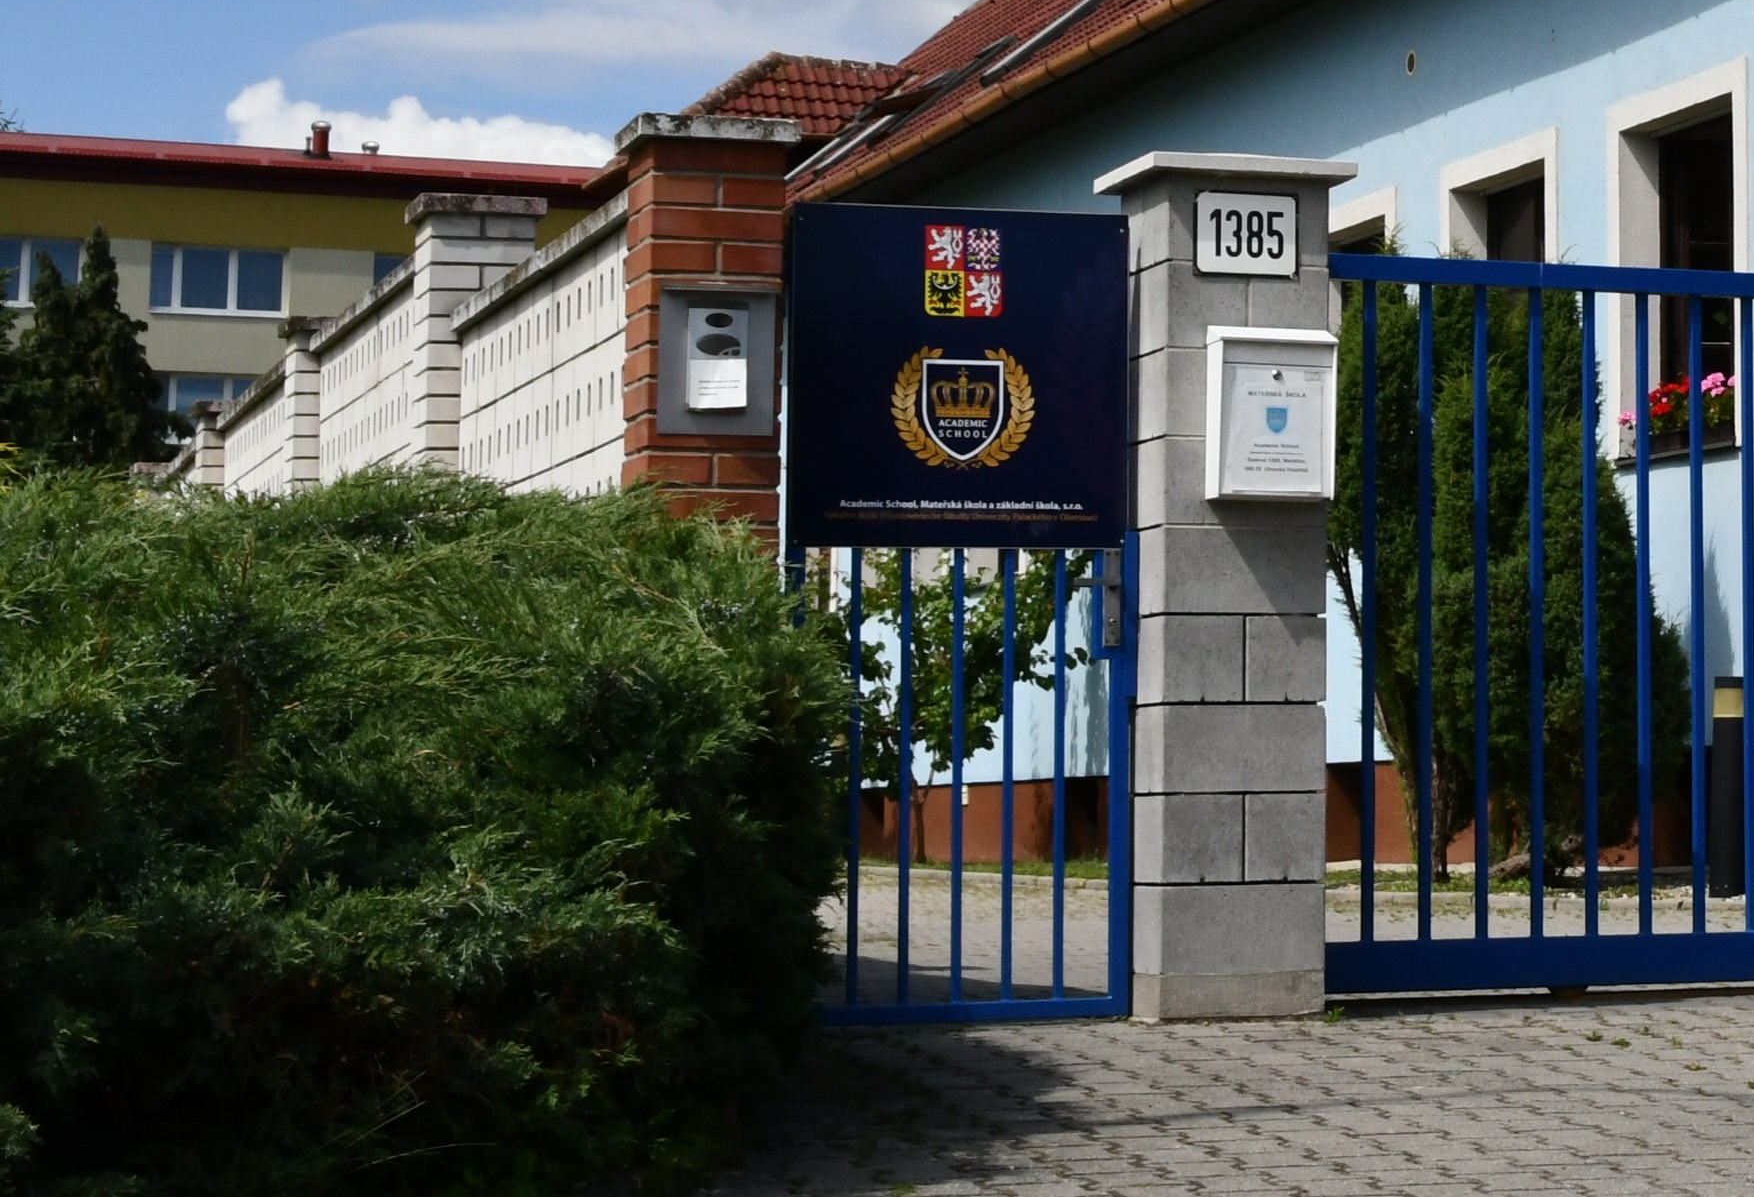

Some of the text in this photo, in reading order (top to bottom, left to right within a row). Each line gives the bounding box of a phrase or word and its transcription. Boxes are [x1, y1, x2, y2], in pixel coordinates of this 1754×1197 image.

[1210, 208, 1284, 259] 1385
[1286, 390, 1306, 398] ŠKOLA
[938, 418, 988, 428] ACADEMIC
[938, 429, 988, 439] SCHOOL
[840, 499, 883, 508] Academic
[885, 499, 919, 509] School,
[920, 500, 962, 509] Mateřská
[964, 500, 987, 509] škola
[996, 500, 1034, 510] základní
[1035, 501, 1061, 511] škola,
[1060, 513, 1098, 521] Olomouci
